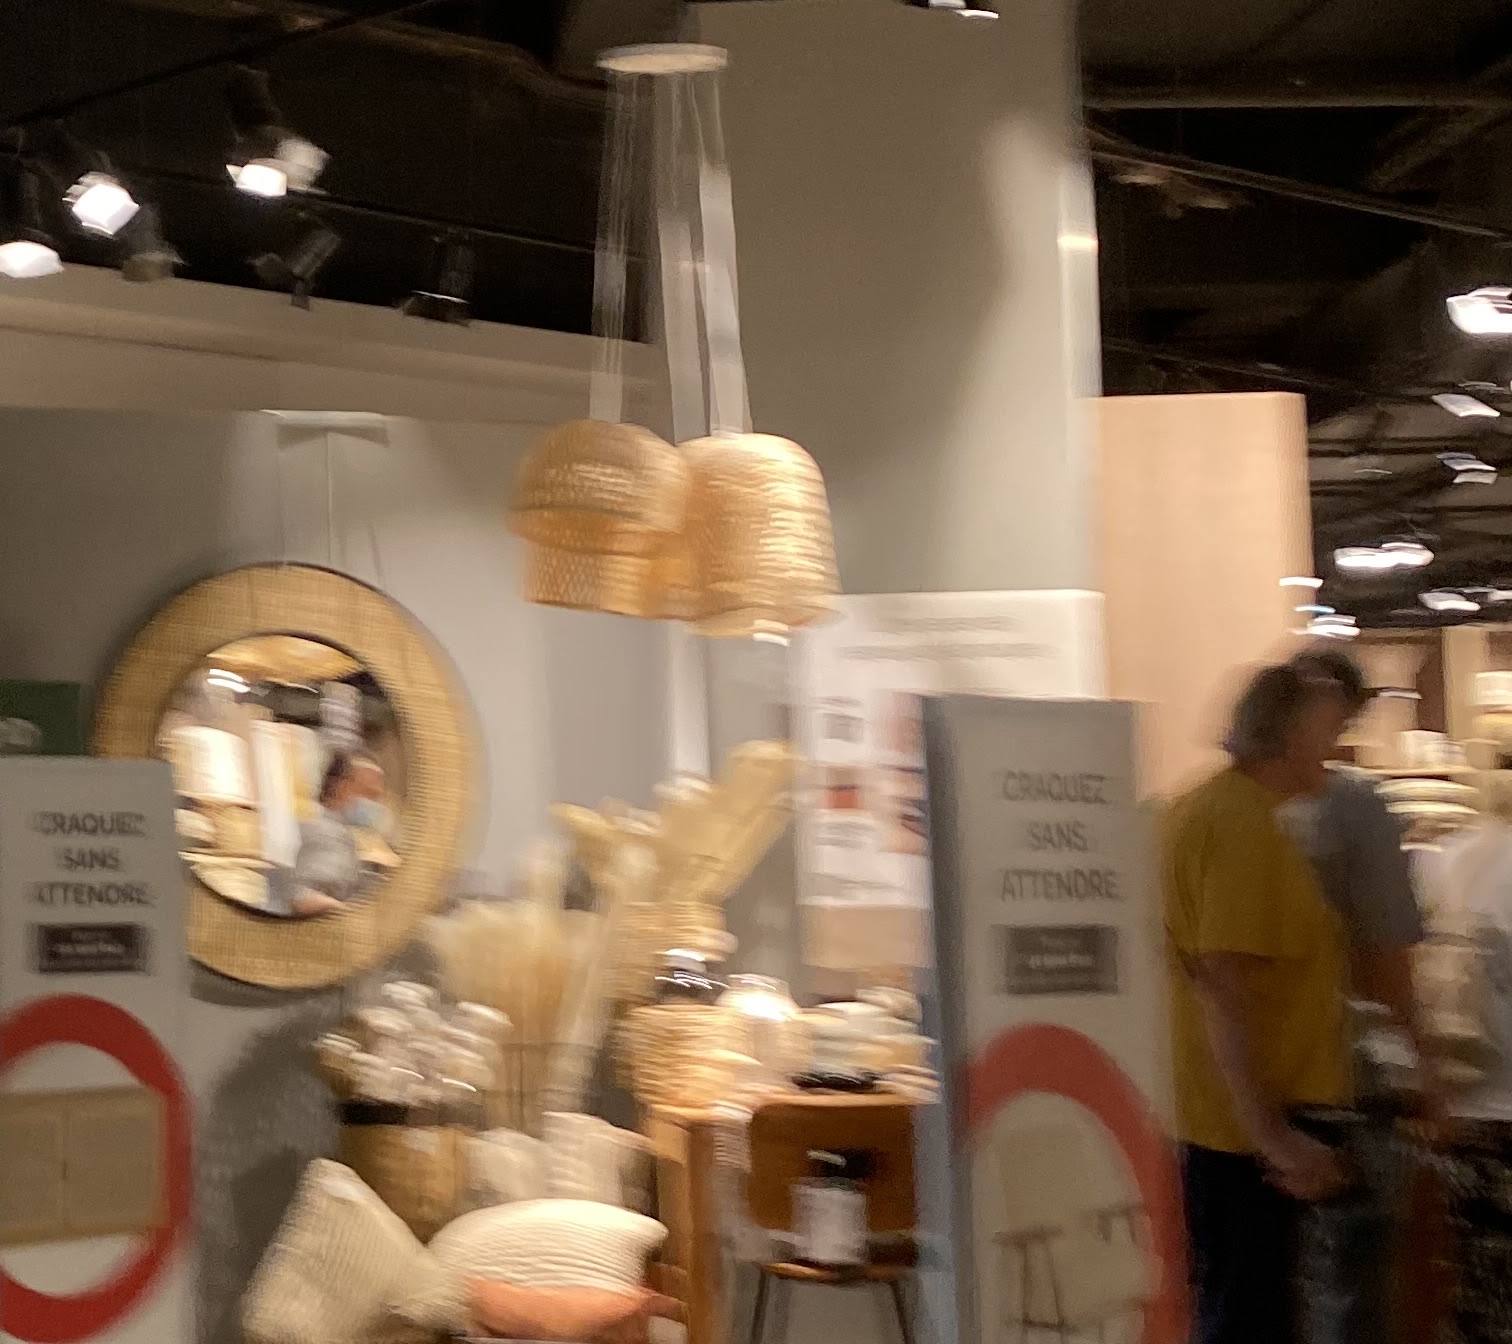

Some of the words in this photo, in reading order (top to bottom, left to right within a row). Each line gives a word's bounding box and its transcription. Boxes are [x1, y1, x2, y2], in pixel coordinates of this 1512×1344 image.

[1001, 770, 1107, 804] CRAQUEZ
[1027, 820, 1088, 851] SANS
[61, 847, 120, 870] SANS
[999, 868, 1122, 903] ATTENDRE
